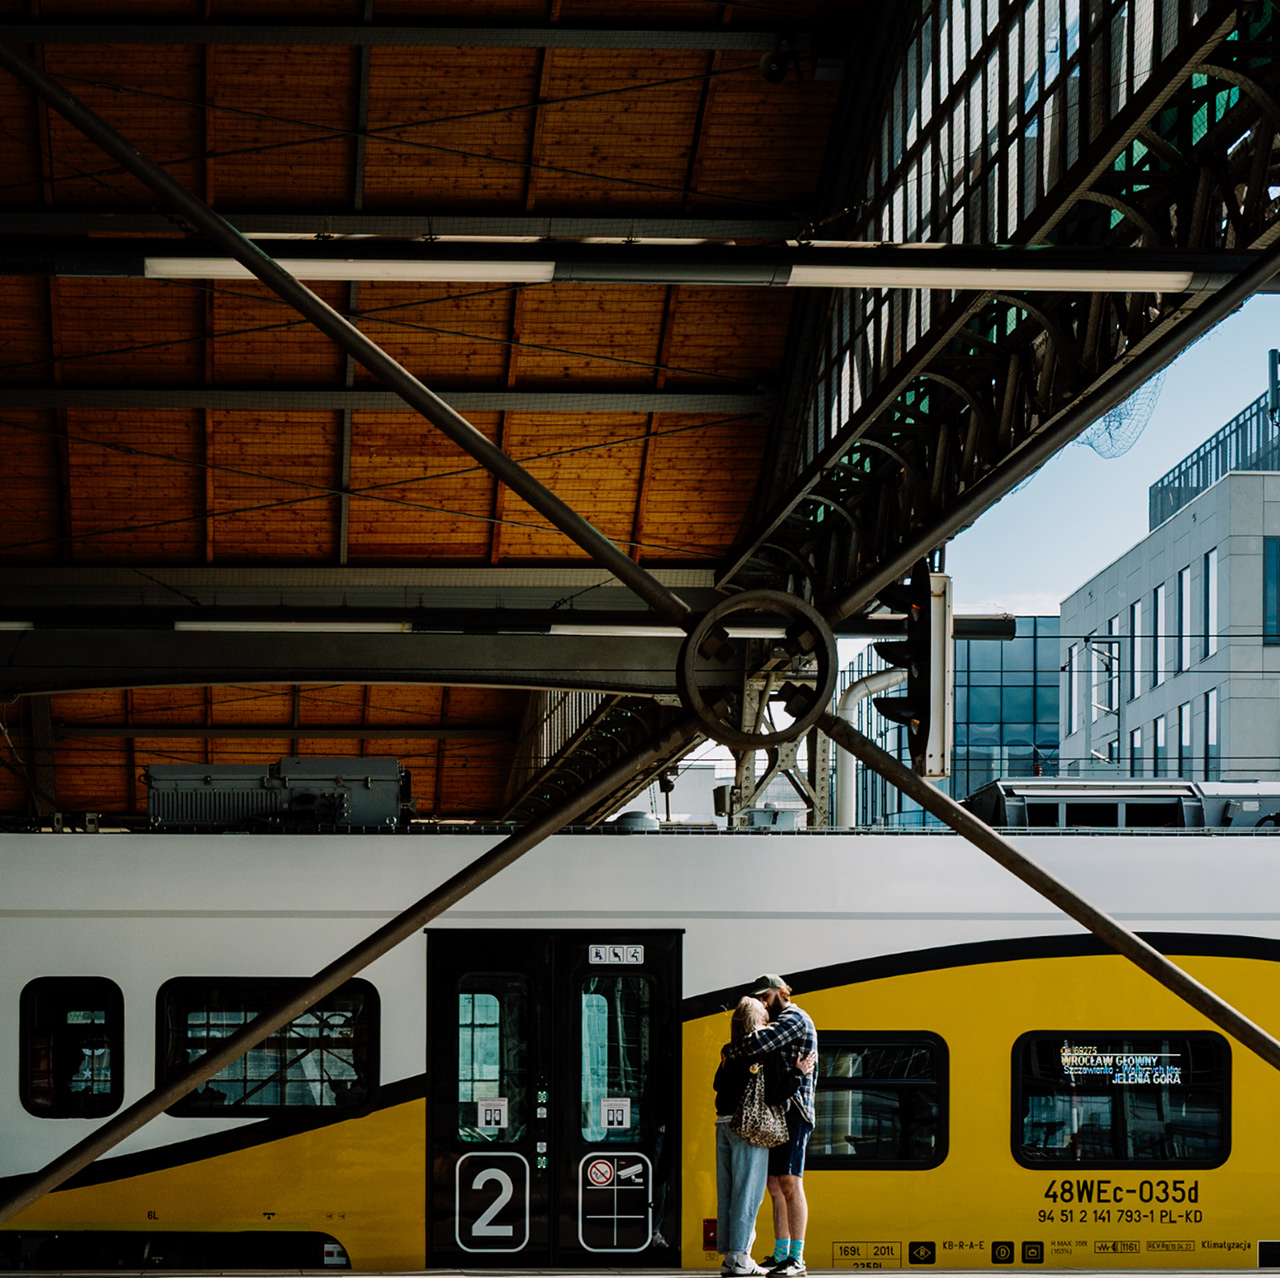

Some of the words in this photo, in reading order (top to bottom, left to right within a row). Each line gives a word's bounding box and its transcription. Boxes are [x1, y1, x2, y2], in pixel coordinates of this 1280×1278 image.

[1061, 1056, 1113, 1066] WROCŁAW
[1112, 1073, 1150, 1084] JELENIA
[1045, 1180, 1198, 1203] 48WEc-035d
[472, 1168, 513, 1236] 2
[147, 1210, 159, 1220] 6L
[1038, 1209, 1055, 1223] 94
[1060, 1209, 1074, 1223] 51
[1080, 1209, 1087, 1223] 2
[1093, 1209, 1111, 1223] 141
[1117, 1209, 1155, 1223] 793-1
[1160, 1209, 1203, 1224] PL-KD
[942, 1240, 985, 1250] KB-R-A-E
[1201, 1240, 1251, 1252] Klimatyzacja
